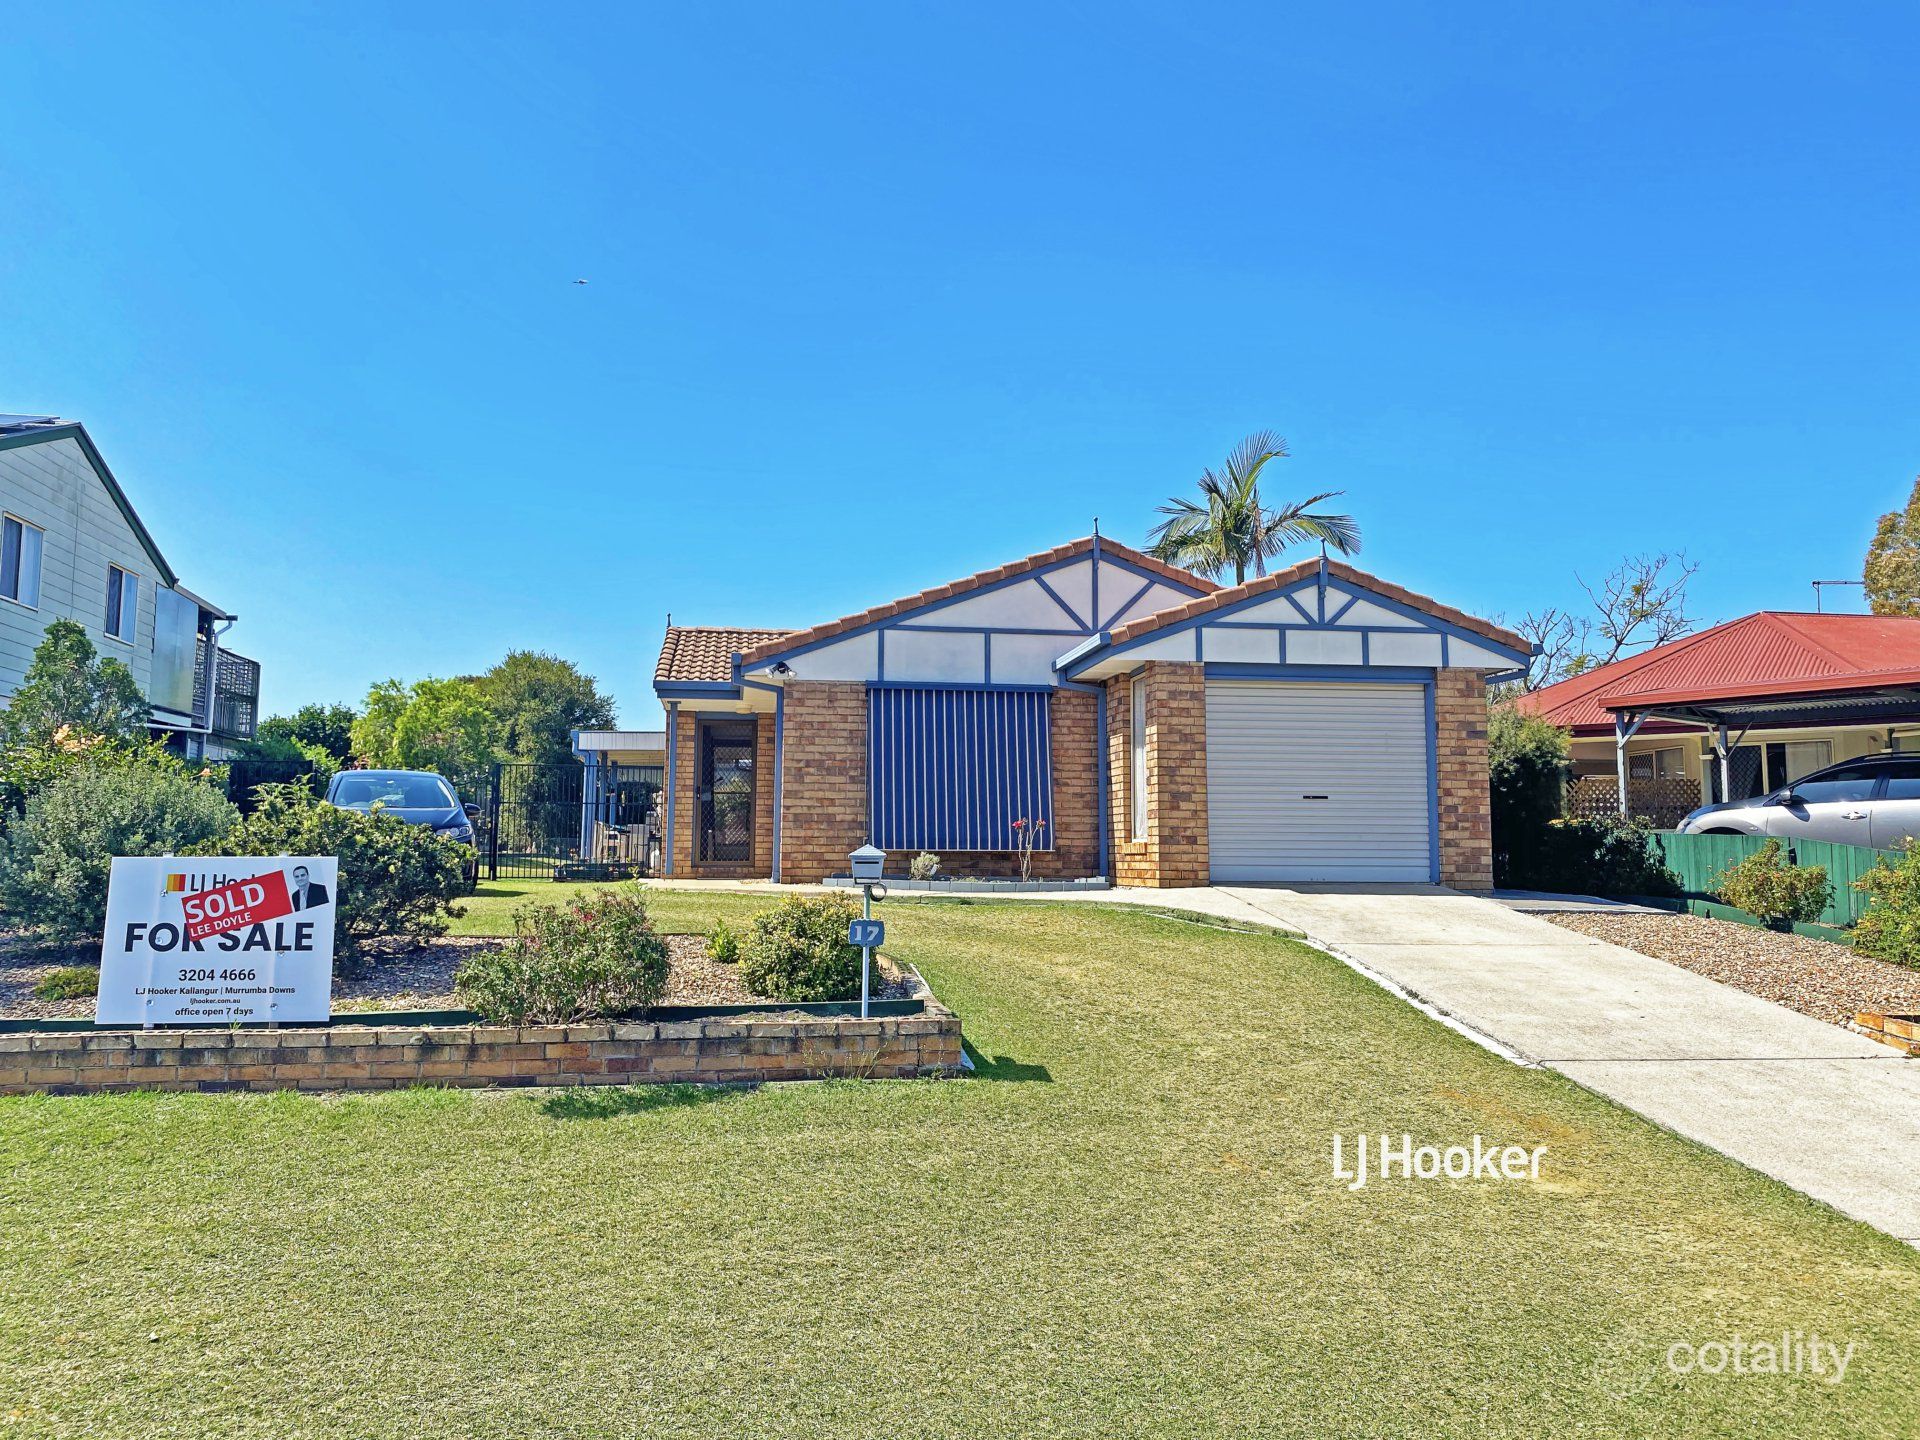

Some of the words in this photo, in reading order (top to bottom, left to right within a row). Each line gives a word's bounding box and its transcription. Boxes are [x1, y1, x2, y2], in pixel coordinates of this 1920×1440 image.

[185, 883, 265, 924] SOLD
[190, 923, 212, 937] LEE
[213, 911, 252, 930] DOYLE
[217, 922, 315, 952] SALE
[854, 925, 880, 941] 17
[178, 969, 215, 981] 3204
[219, 968, 256, 981] 4666
[147, 987, 178, 995] Hooker
[179, 987, 219, 996] Kallangur
[225, 986, 267, 994] Murrumba
[269, 986, 296, 994] Downs
[175, 1008, 200, 1016] office
[202, 1009, 224, 1017] open
[226, 1007, 232, 1016] 7
[233, 1007, 254, 1017] days
